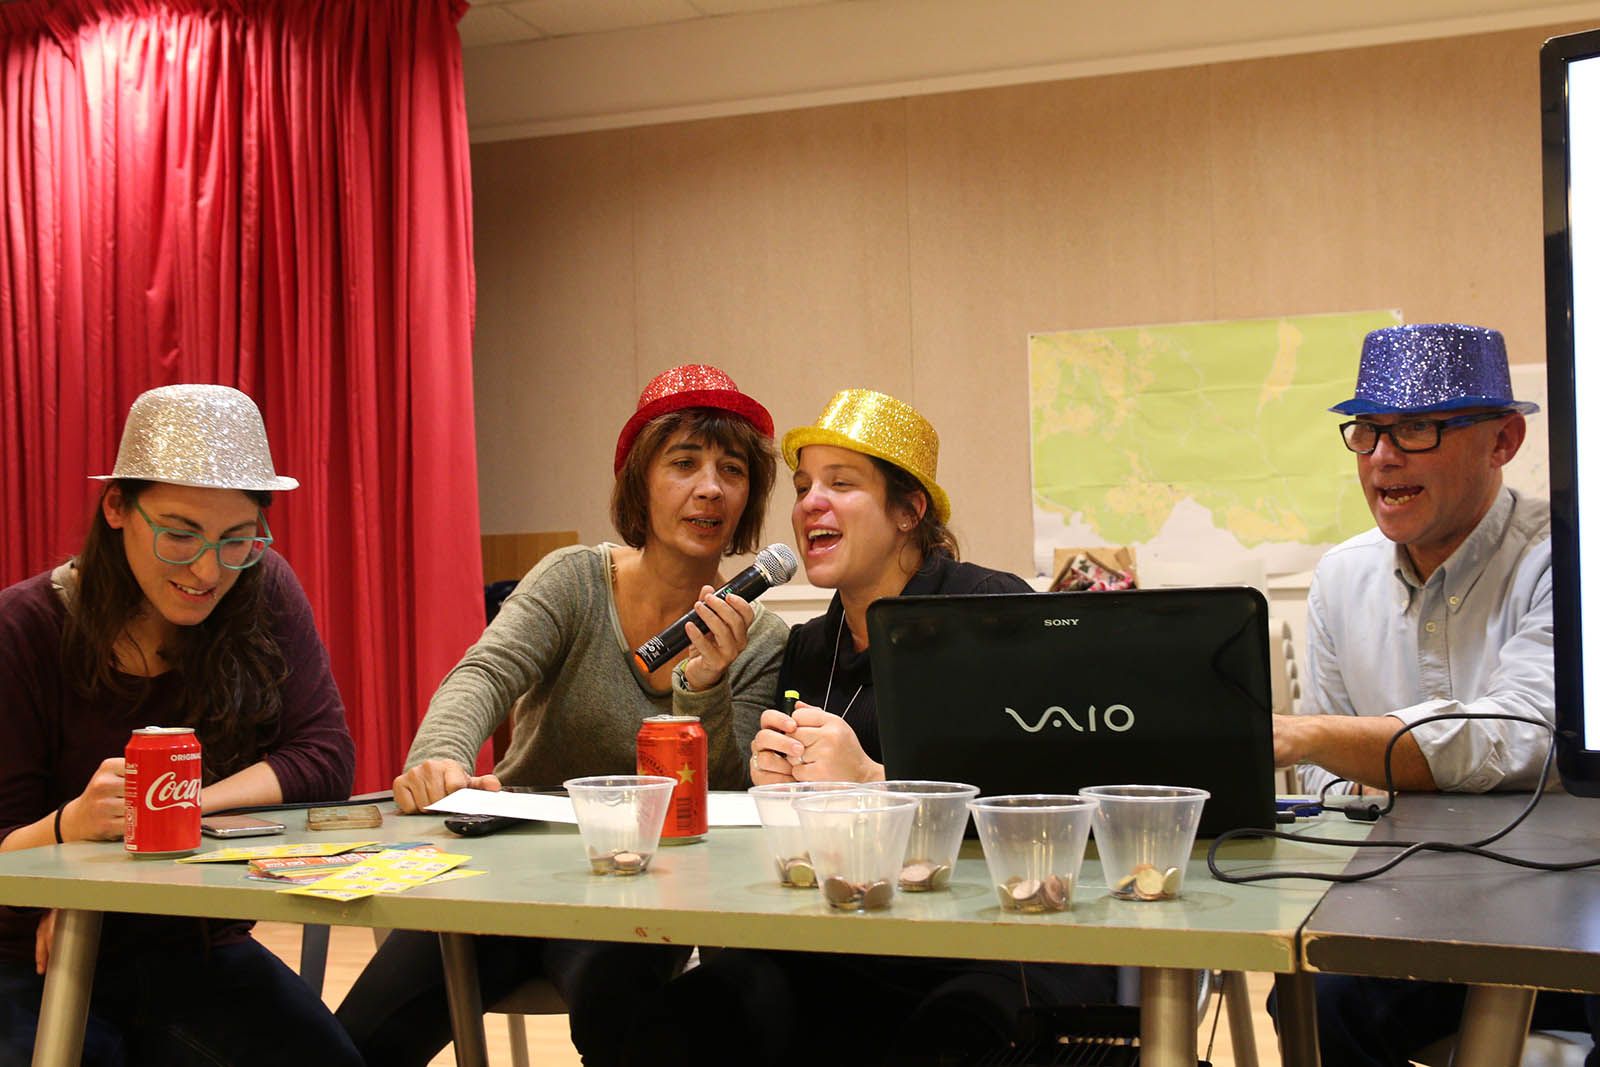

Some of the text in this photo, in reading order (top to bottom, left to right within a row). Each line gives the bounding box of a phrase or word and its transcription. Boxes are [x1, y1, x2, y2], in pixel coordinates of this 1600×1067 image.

[1044, 618, 1079, 627] SONY
[1005, 704, 1135, 733] VAIO
[145, 771, 202, 811] Coca
